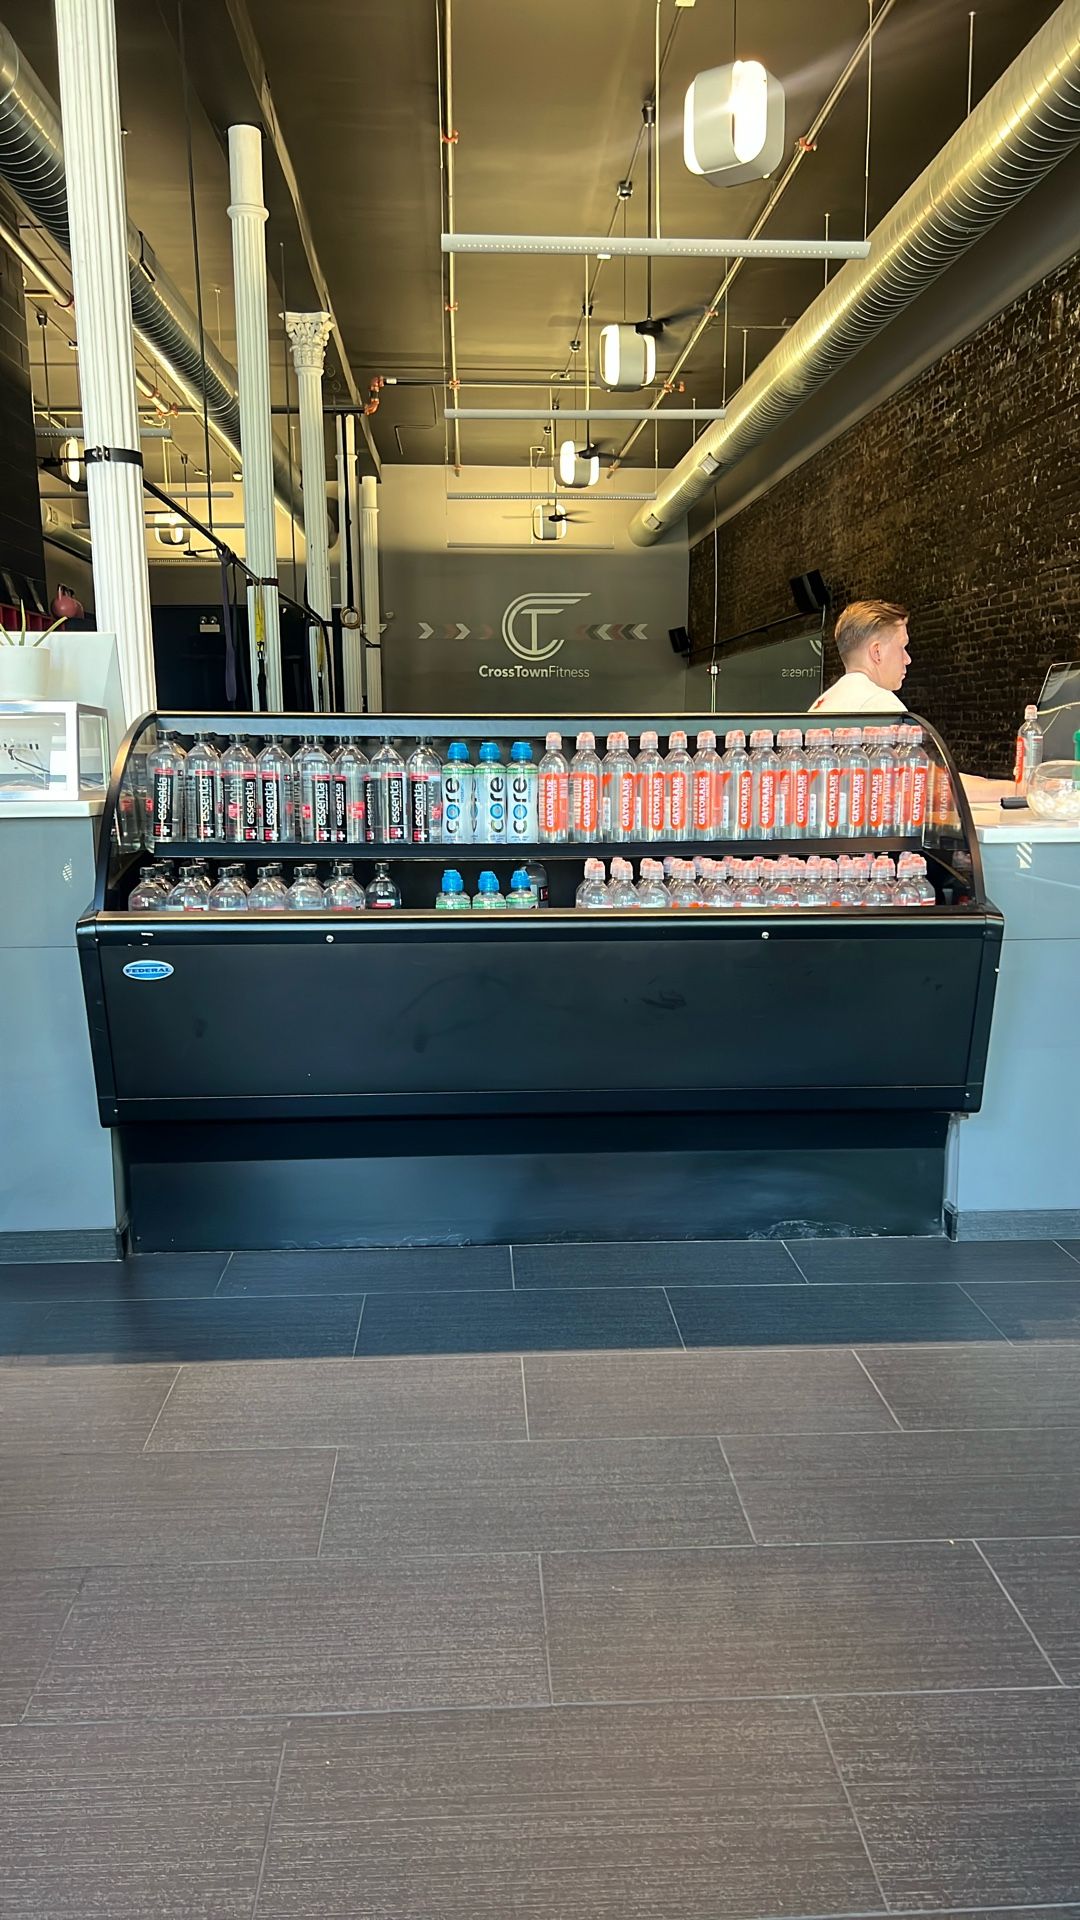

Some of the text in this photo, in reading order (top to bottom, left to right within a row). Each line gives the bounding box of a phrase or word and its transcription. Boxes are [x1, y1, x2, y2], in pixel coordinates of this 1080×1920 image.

[479, 665, 590, 678] CrossTownFitness
[158, 777, 168, 821] essentia
[199, 778, 209, 822] essentia
[245, 781, 254, 825] essentia
[264, 782, 274, 826] essentia
[316, 783, 327, 826] essentia
[390, 780, 400, 824] essentia
[413, 783, 424, 827] essentia
[446, 777, 460, 834] core
[490, 777, 504, 833] core
[513, 777, 527, 834] core
[546, 780, 554, 828] GATORADE
[583, 780, 591, 827] GATORADE
[672, 777, 680, 825] GATORADE
[698, 777, 706, 825] GATORADE
[741, 777, 749, 825] GATORADE
[762, 776, 770, 824] GATORADE
[797, 775, 805, 823] GATORADE
[829, 774, 837, 822] GATORADE
[852, 774, 861, 821] GATORADE
[870, 774, 879, 821] GATORADE
[913, 773, 922, 821] GATORADE
